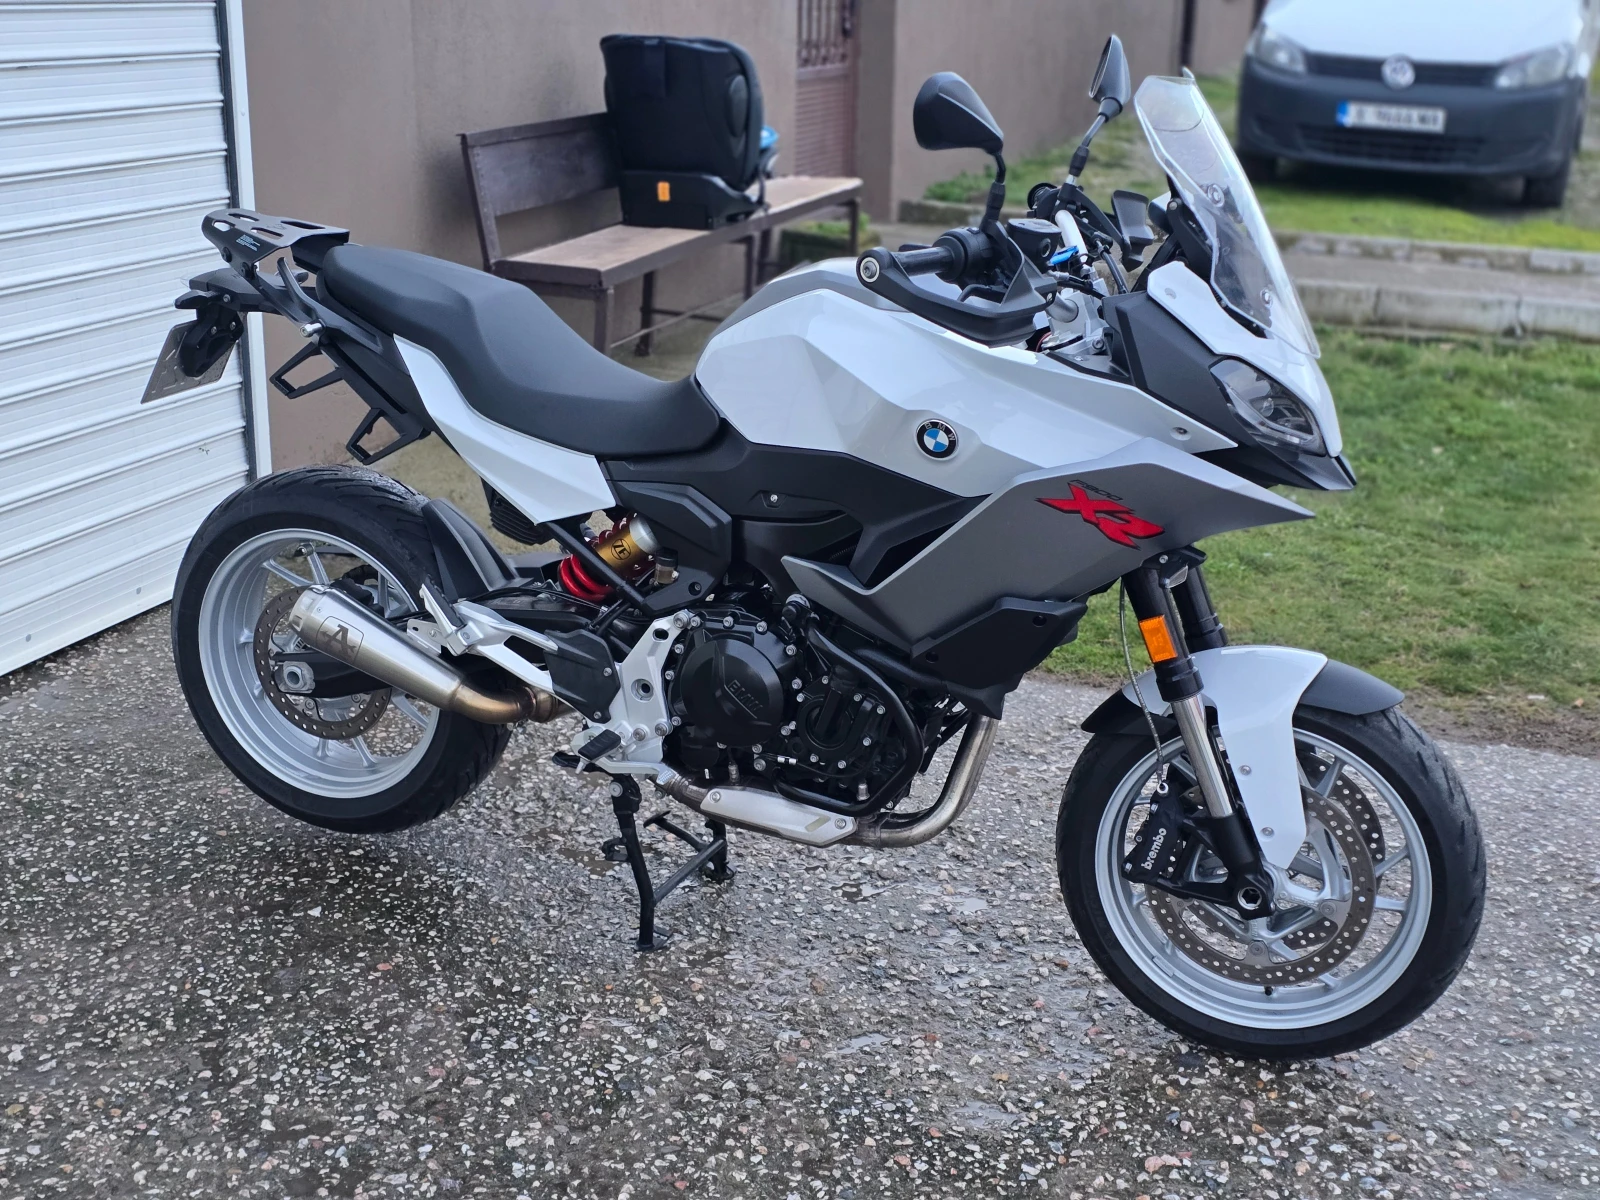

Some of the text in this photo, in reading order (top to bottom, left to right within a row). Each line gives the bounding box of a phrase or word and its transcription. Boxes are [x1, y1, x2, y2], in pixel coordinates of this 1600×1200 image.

[924, 421, 956, 441] BMW
[1034, 482, 1165, 551] XR
[611, 539, 631, 560] ZF
[1140, 827, 1167, 870] brembo
